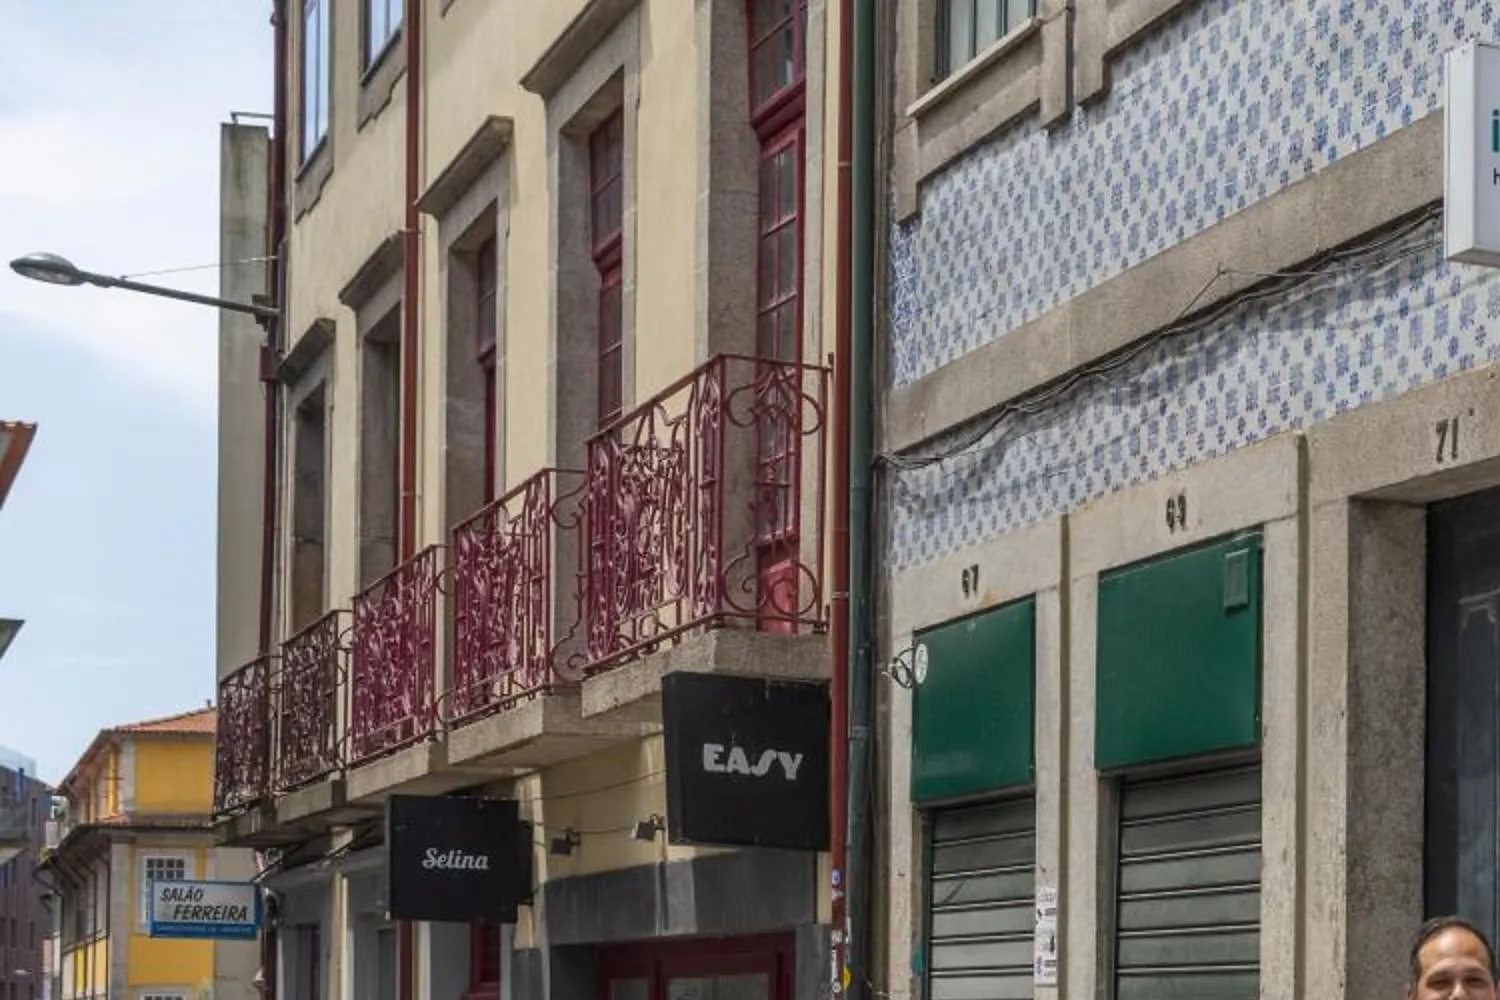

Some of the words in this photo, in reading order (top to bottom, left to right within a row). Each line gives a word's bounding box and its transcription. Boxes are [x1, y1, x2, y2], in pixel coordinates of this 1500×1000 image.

[1435, 416, 1459, 465] 71
[961, 563, 980, 599] 67
[703, 743, 804, 781] EASY
[421, 847, 490, 870] Selina
[160, 886, 205, 902] SALÃO
[173, 903, 248, 922] FERREIRA
